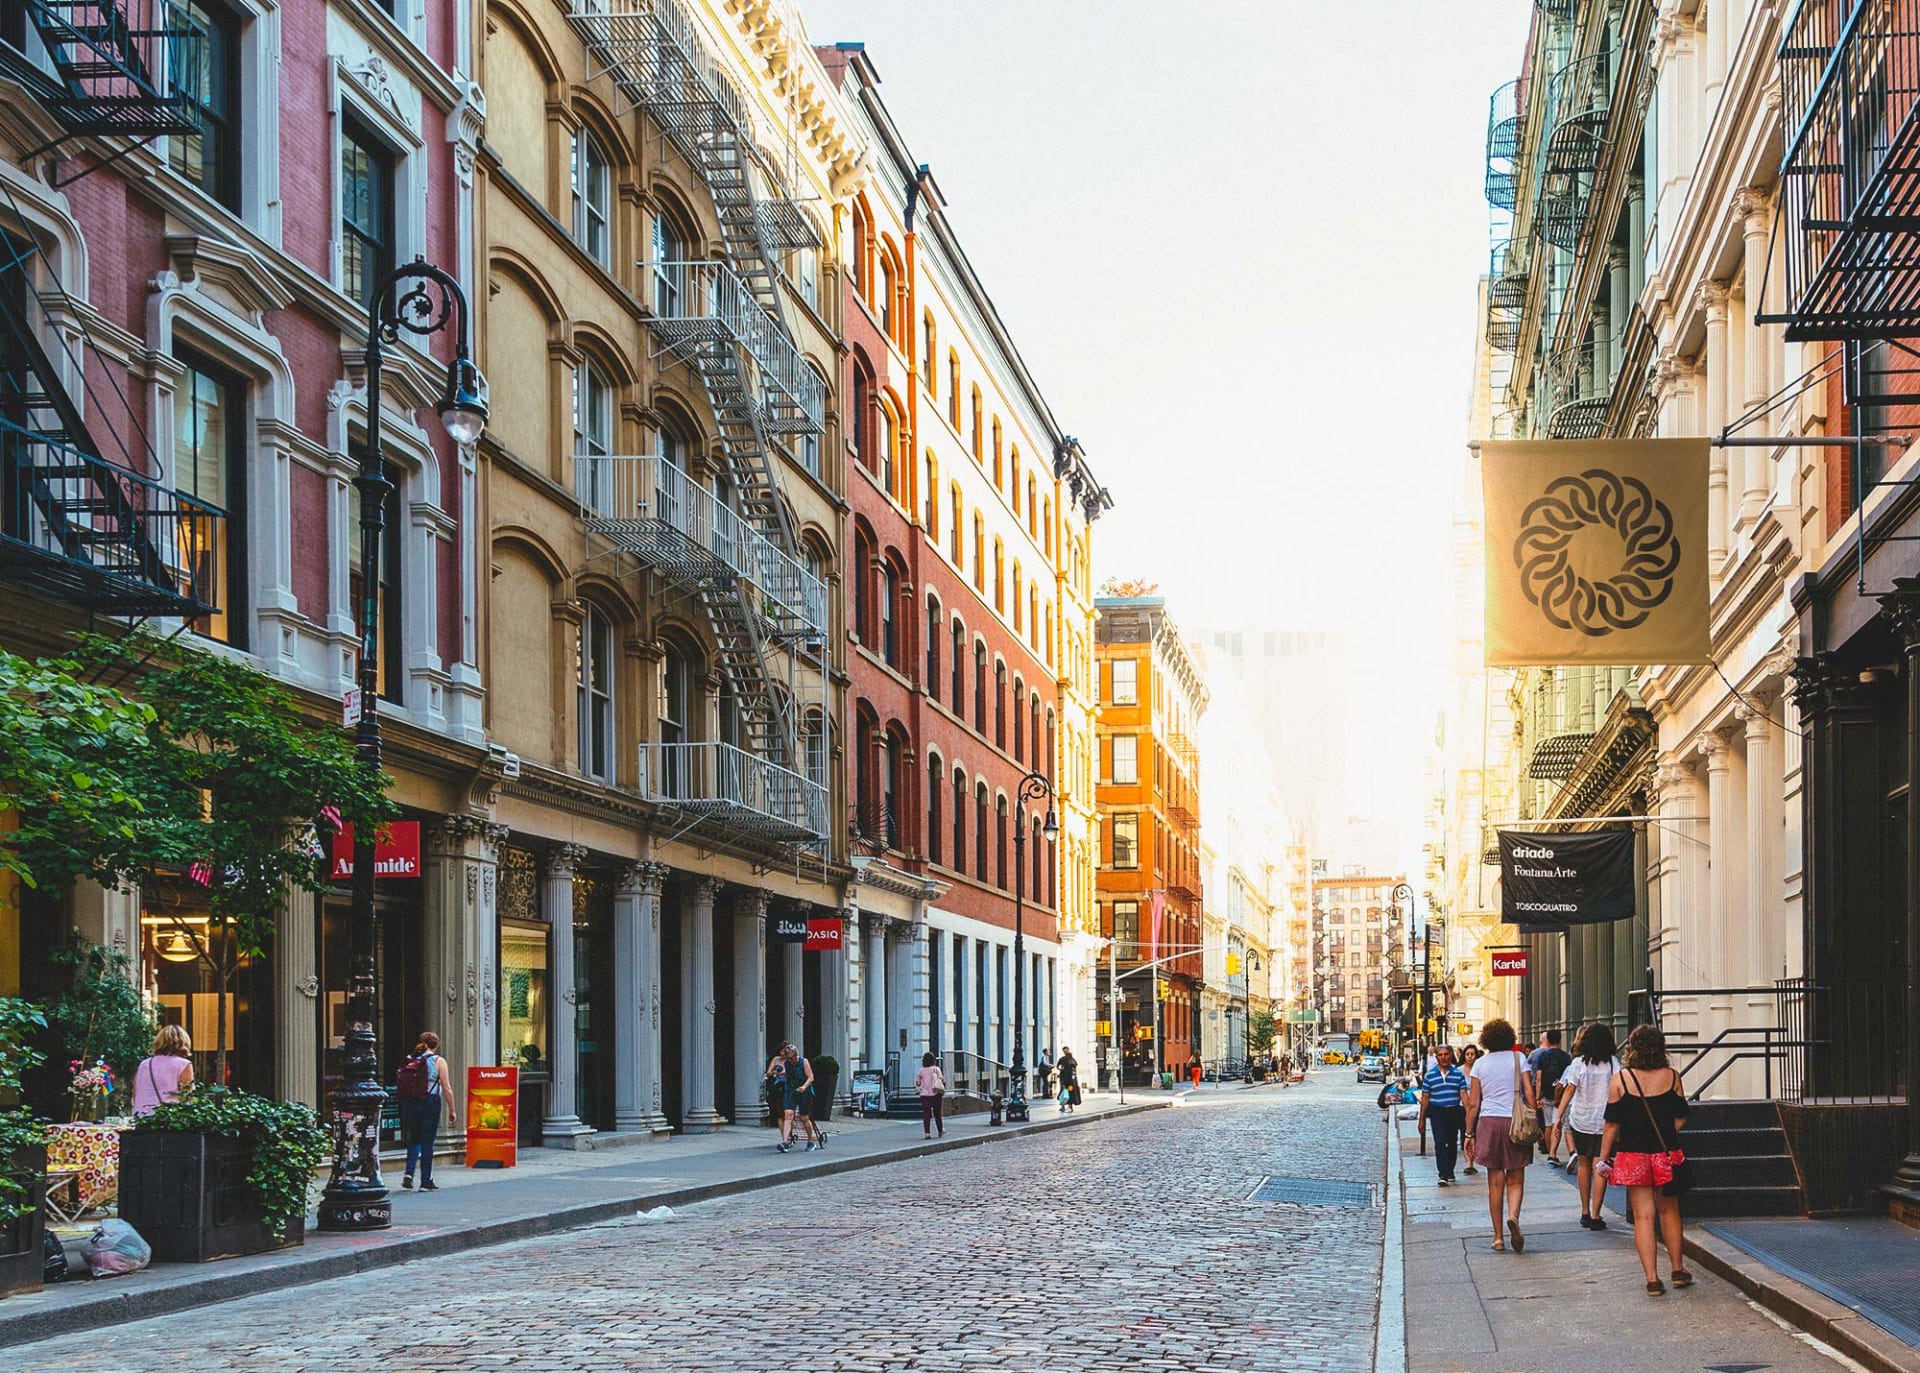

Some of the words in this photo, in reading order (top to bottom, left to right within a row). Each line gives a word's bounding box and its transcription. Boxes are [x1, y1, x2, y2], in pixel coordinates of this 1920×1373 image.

[1512, 846, 1554, 859] driade
[1514, 864, 1577, 878] FontanaArte
[1515, 902, 1578, 912] TOSCOQUATTRO
[1493, 959, 1527, 970] Kartell
